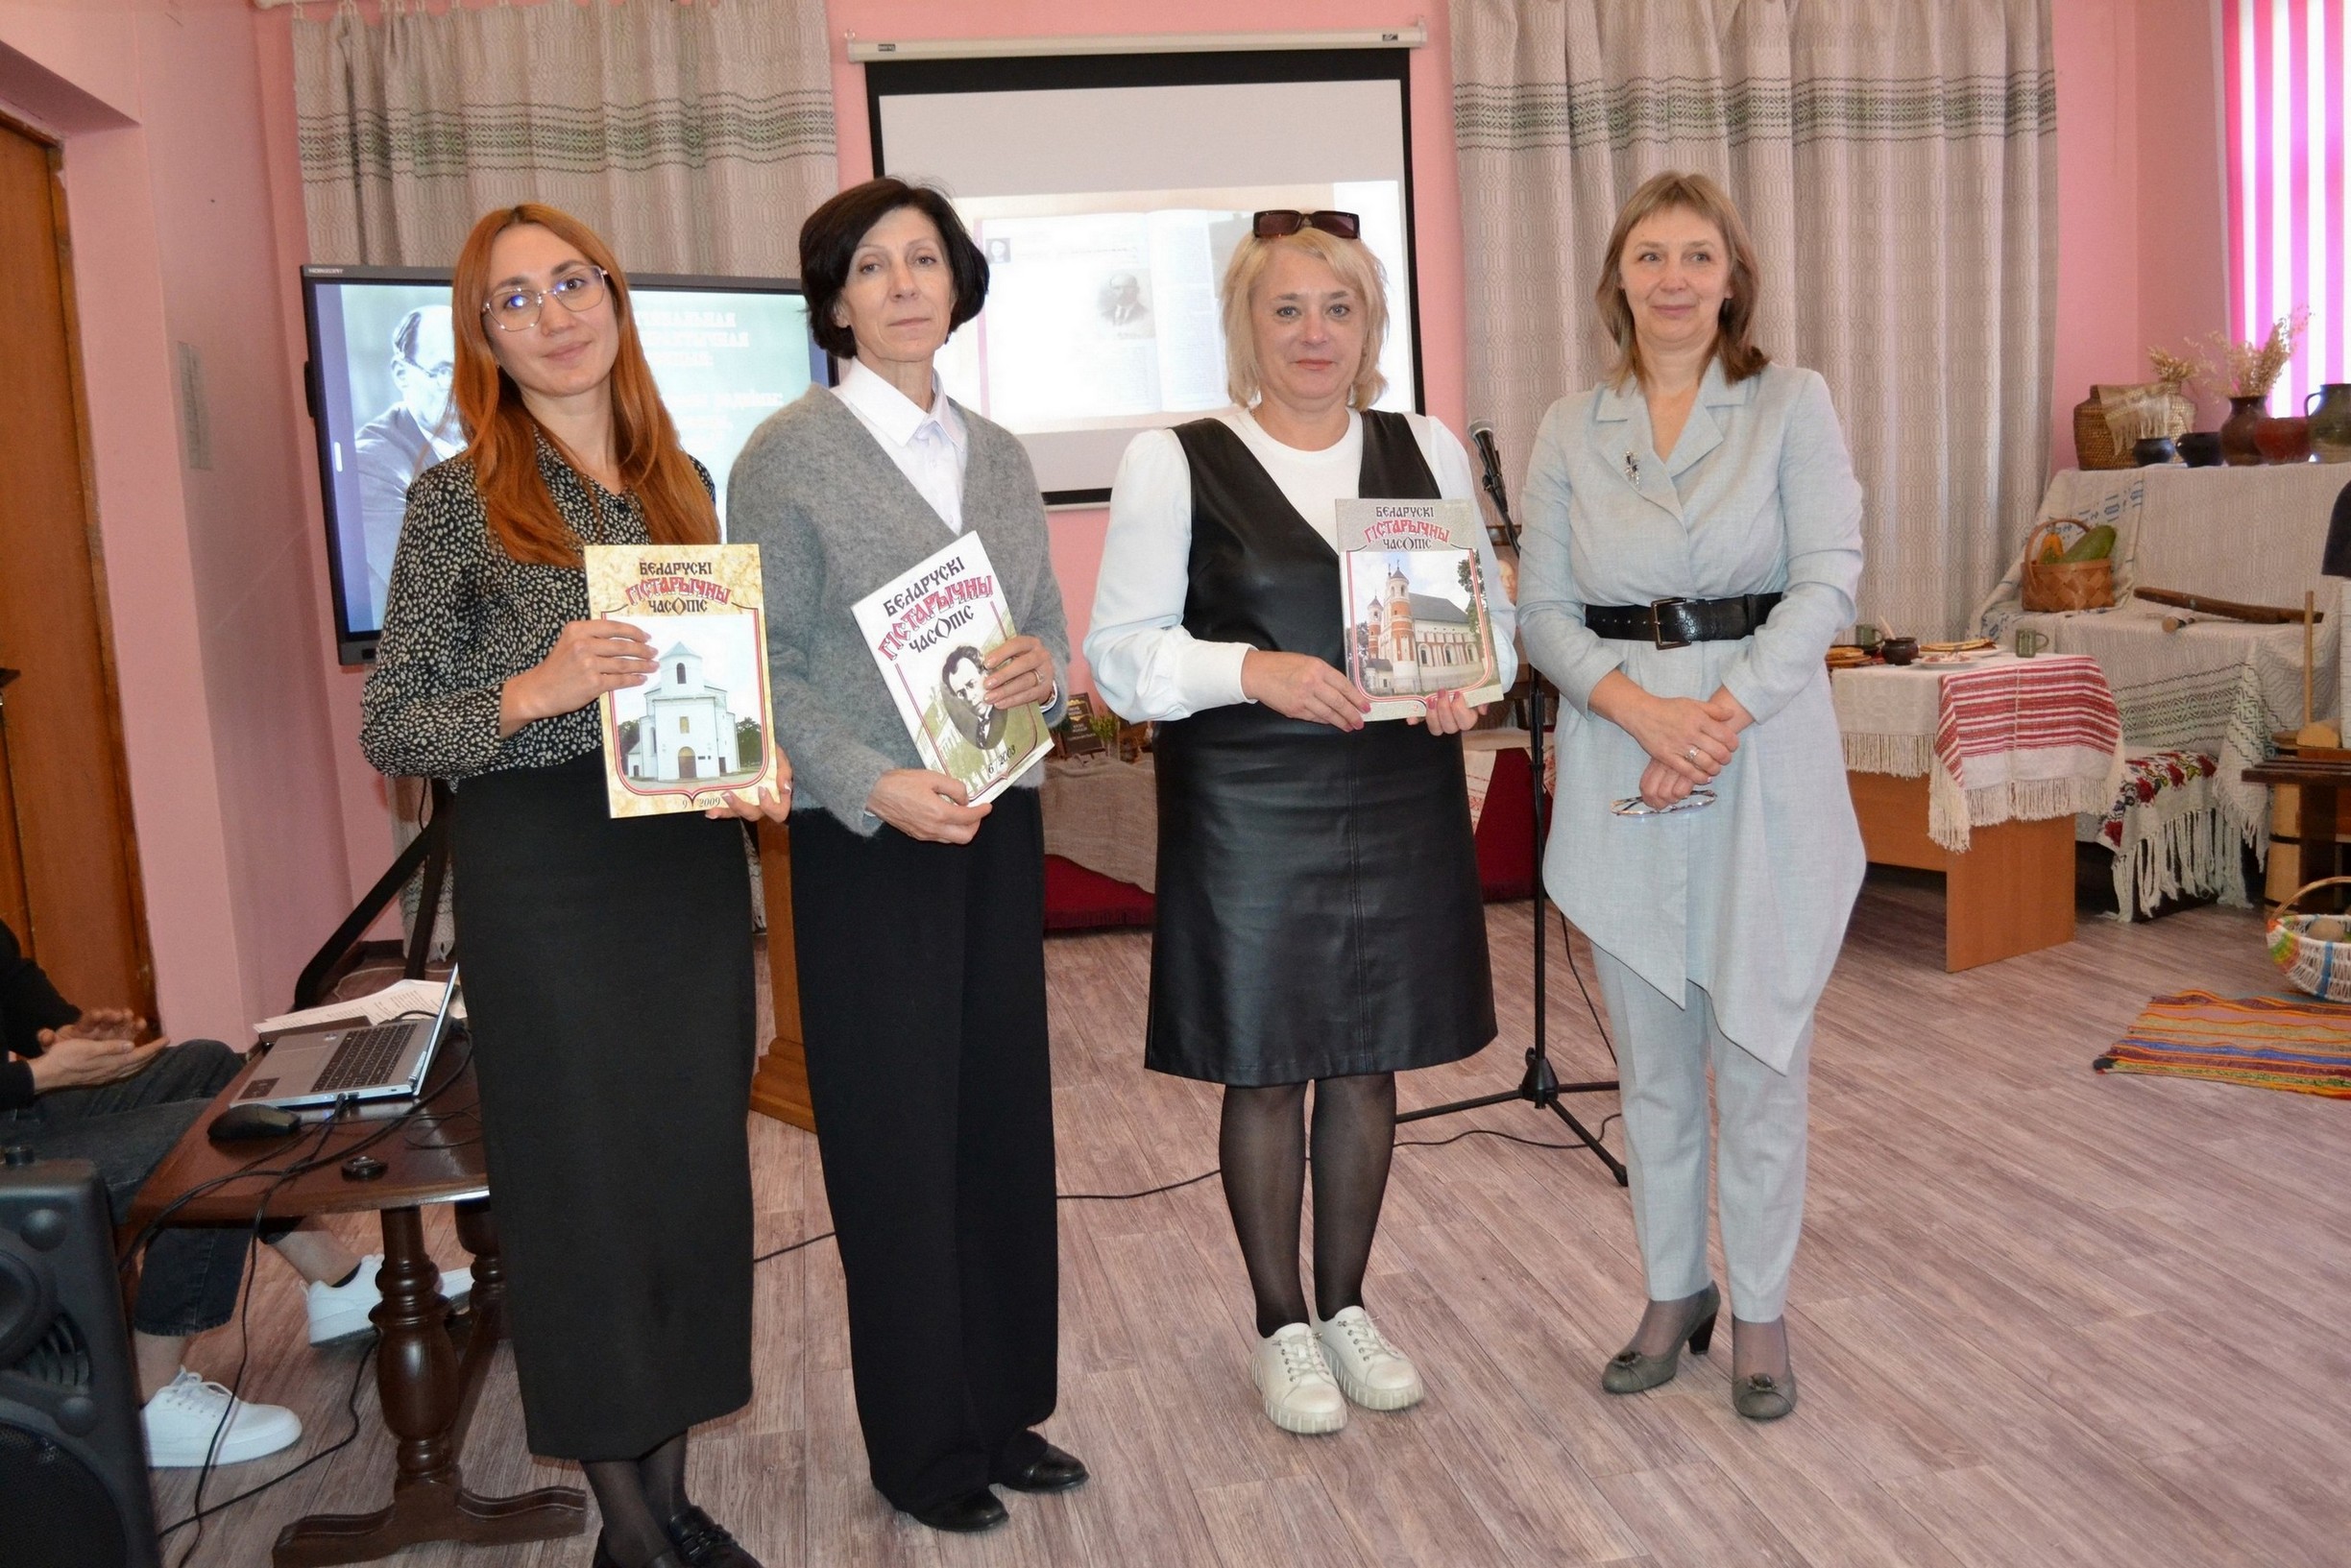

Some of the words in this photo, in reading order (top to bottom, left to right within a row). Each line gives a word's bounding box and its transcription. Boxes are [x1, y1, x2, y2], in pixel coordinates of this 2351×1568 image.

[1376, 506, 1434, 518] БЕЛАРУСКІ
[1364, 519, 1450, 543] ГІСТАРЫЧНЫ
[1383, 537, 1432, 550] ЧАСОПІС
[640, 562, 713, 575] БЕЛАРУСКІ
[625, 576, 732, 605] ГІСТАРЫЧНЫ
[883, 556, 965, 617] БЕЛАРУСКІ
[648, 597, 708, 615] ЧАСОПІС
[878, 575, 994, 662] ГІСТАРЫЧНЫ
[909, 605, 974, 653] ЧАСОПІС
[699, 797, 721, 808] 2009
